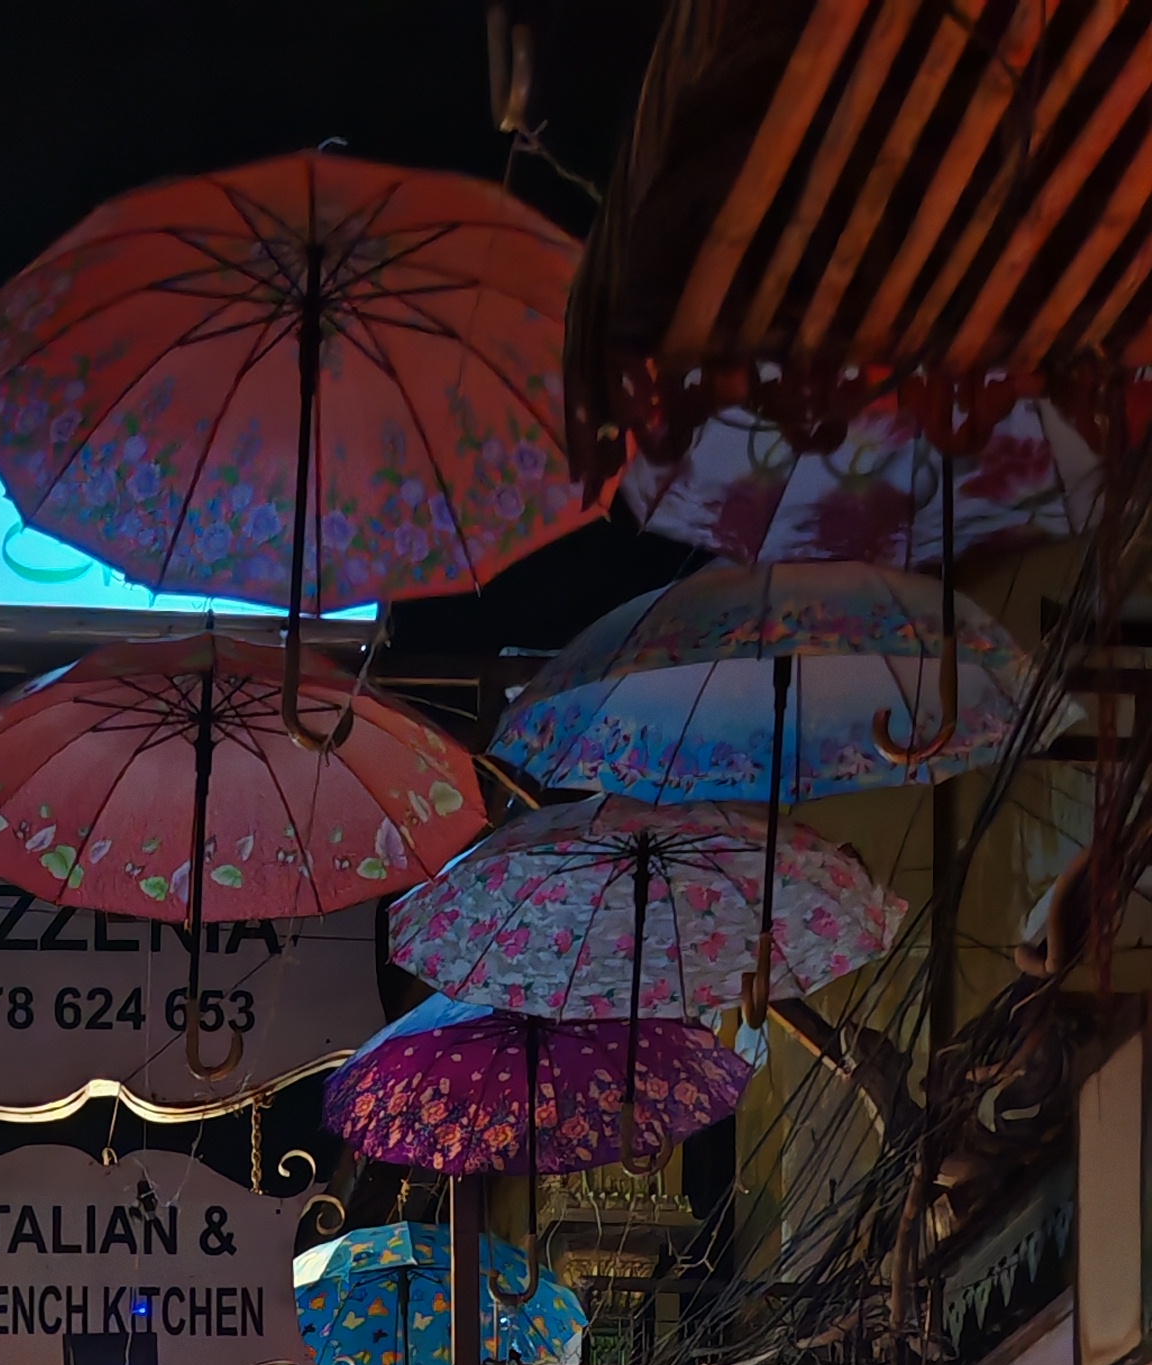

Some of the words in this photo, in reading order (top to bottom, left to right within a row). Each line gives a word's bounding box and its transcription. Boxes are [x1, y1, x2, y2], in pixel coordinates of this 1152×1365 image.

[54, 987, 146, 1031] 624
[165, 987, 255, 1032] 653
[199, 1205, 237, 1256] &
[103, 1286, 263, 1336] KITCHEN
